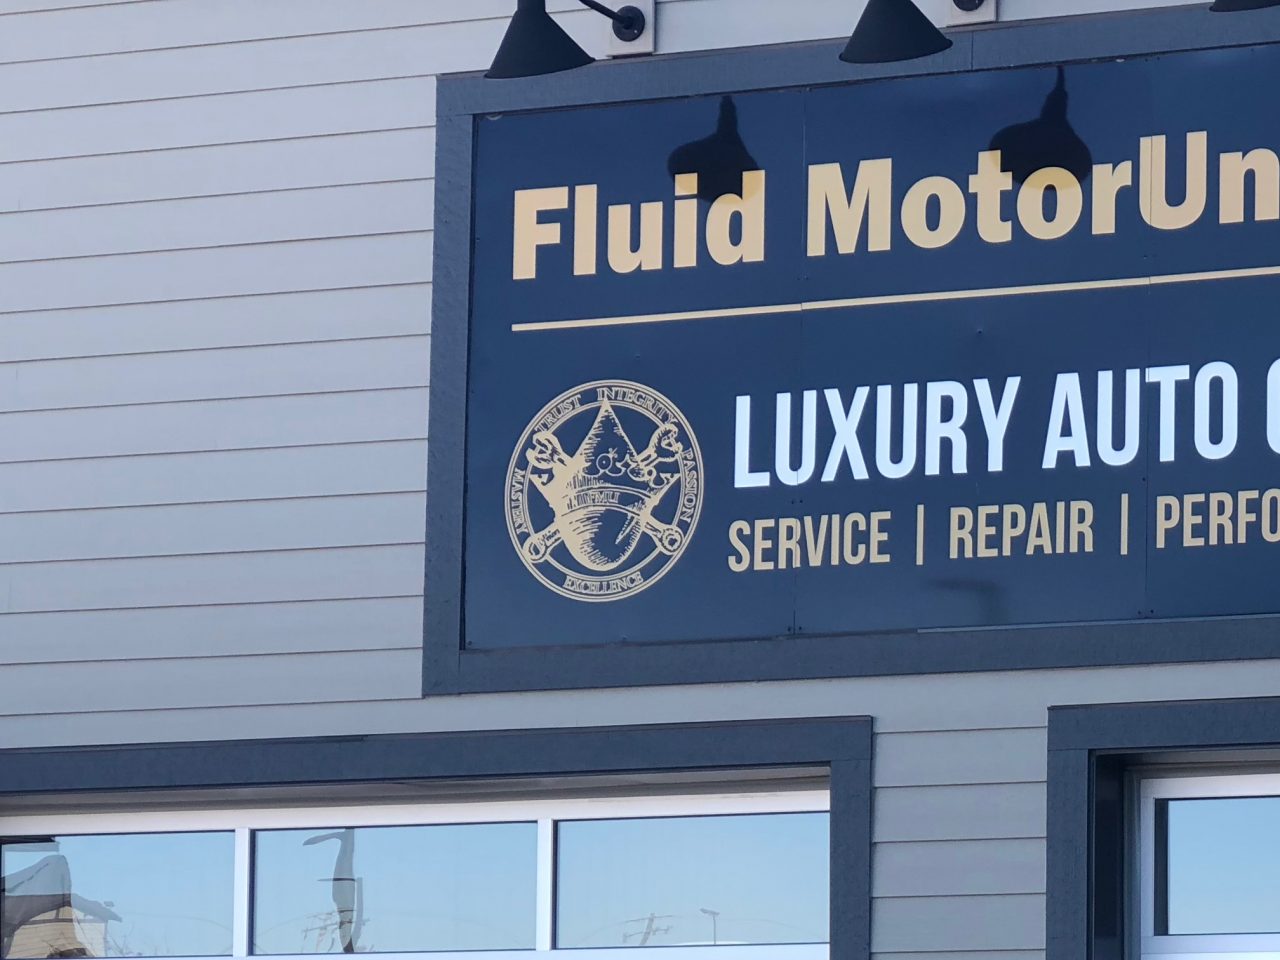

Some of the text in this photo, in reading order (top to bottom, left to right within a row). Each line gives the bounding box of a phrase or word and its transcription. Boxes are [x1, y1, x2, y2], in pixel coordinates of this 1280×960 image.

[513, 170, 765, 280] Fluid
[533, 393, 582, 434] TRUST
[596, 386, 680, 424] INTEGRITY
[734, 376, 1021, 488] LUXURY
[1042, 362, 1238, 468] AUTO
[510, 467, 530, 536] MASTERY
[681, 448, 699, 524] PASSION
[728, 511, 891, 572] SERVICE
[950, 501, 1093, 558] REPAIR
[563, 573, 644, 594] EXCELLENCE
